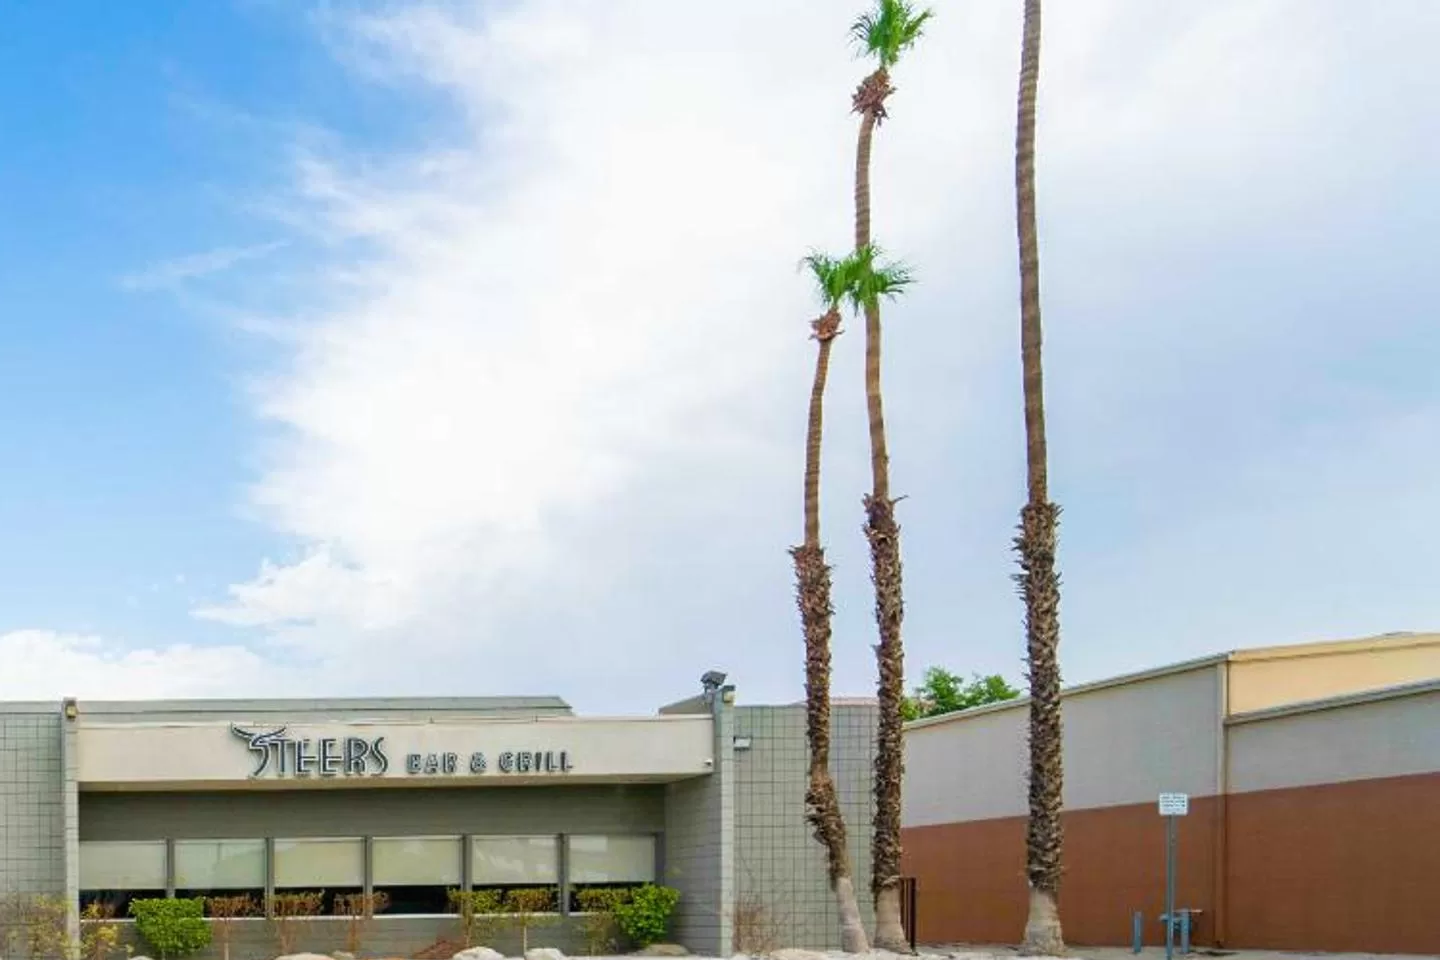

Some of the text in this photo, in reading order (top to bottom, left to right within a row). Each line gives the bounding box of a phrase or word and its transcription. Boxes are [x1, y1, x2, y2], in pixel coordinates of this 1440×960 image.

[231, 722, 574, 778] STEERS BAR & GRILL
